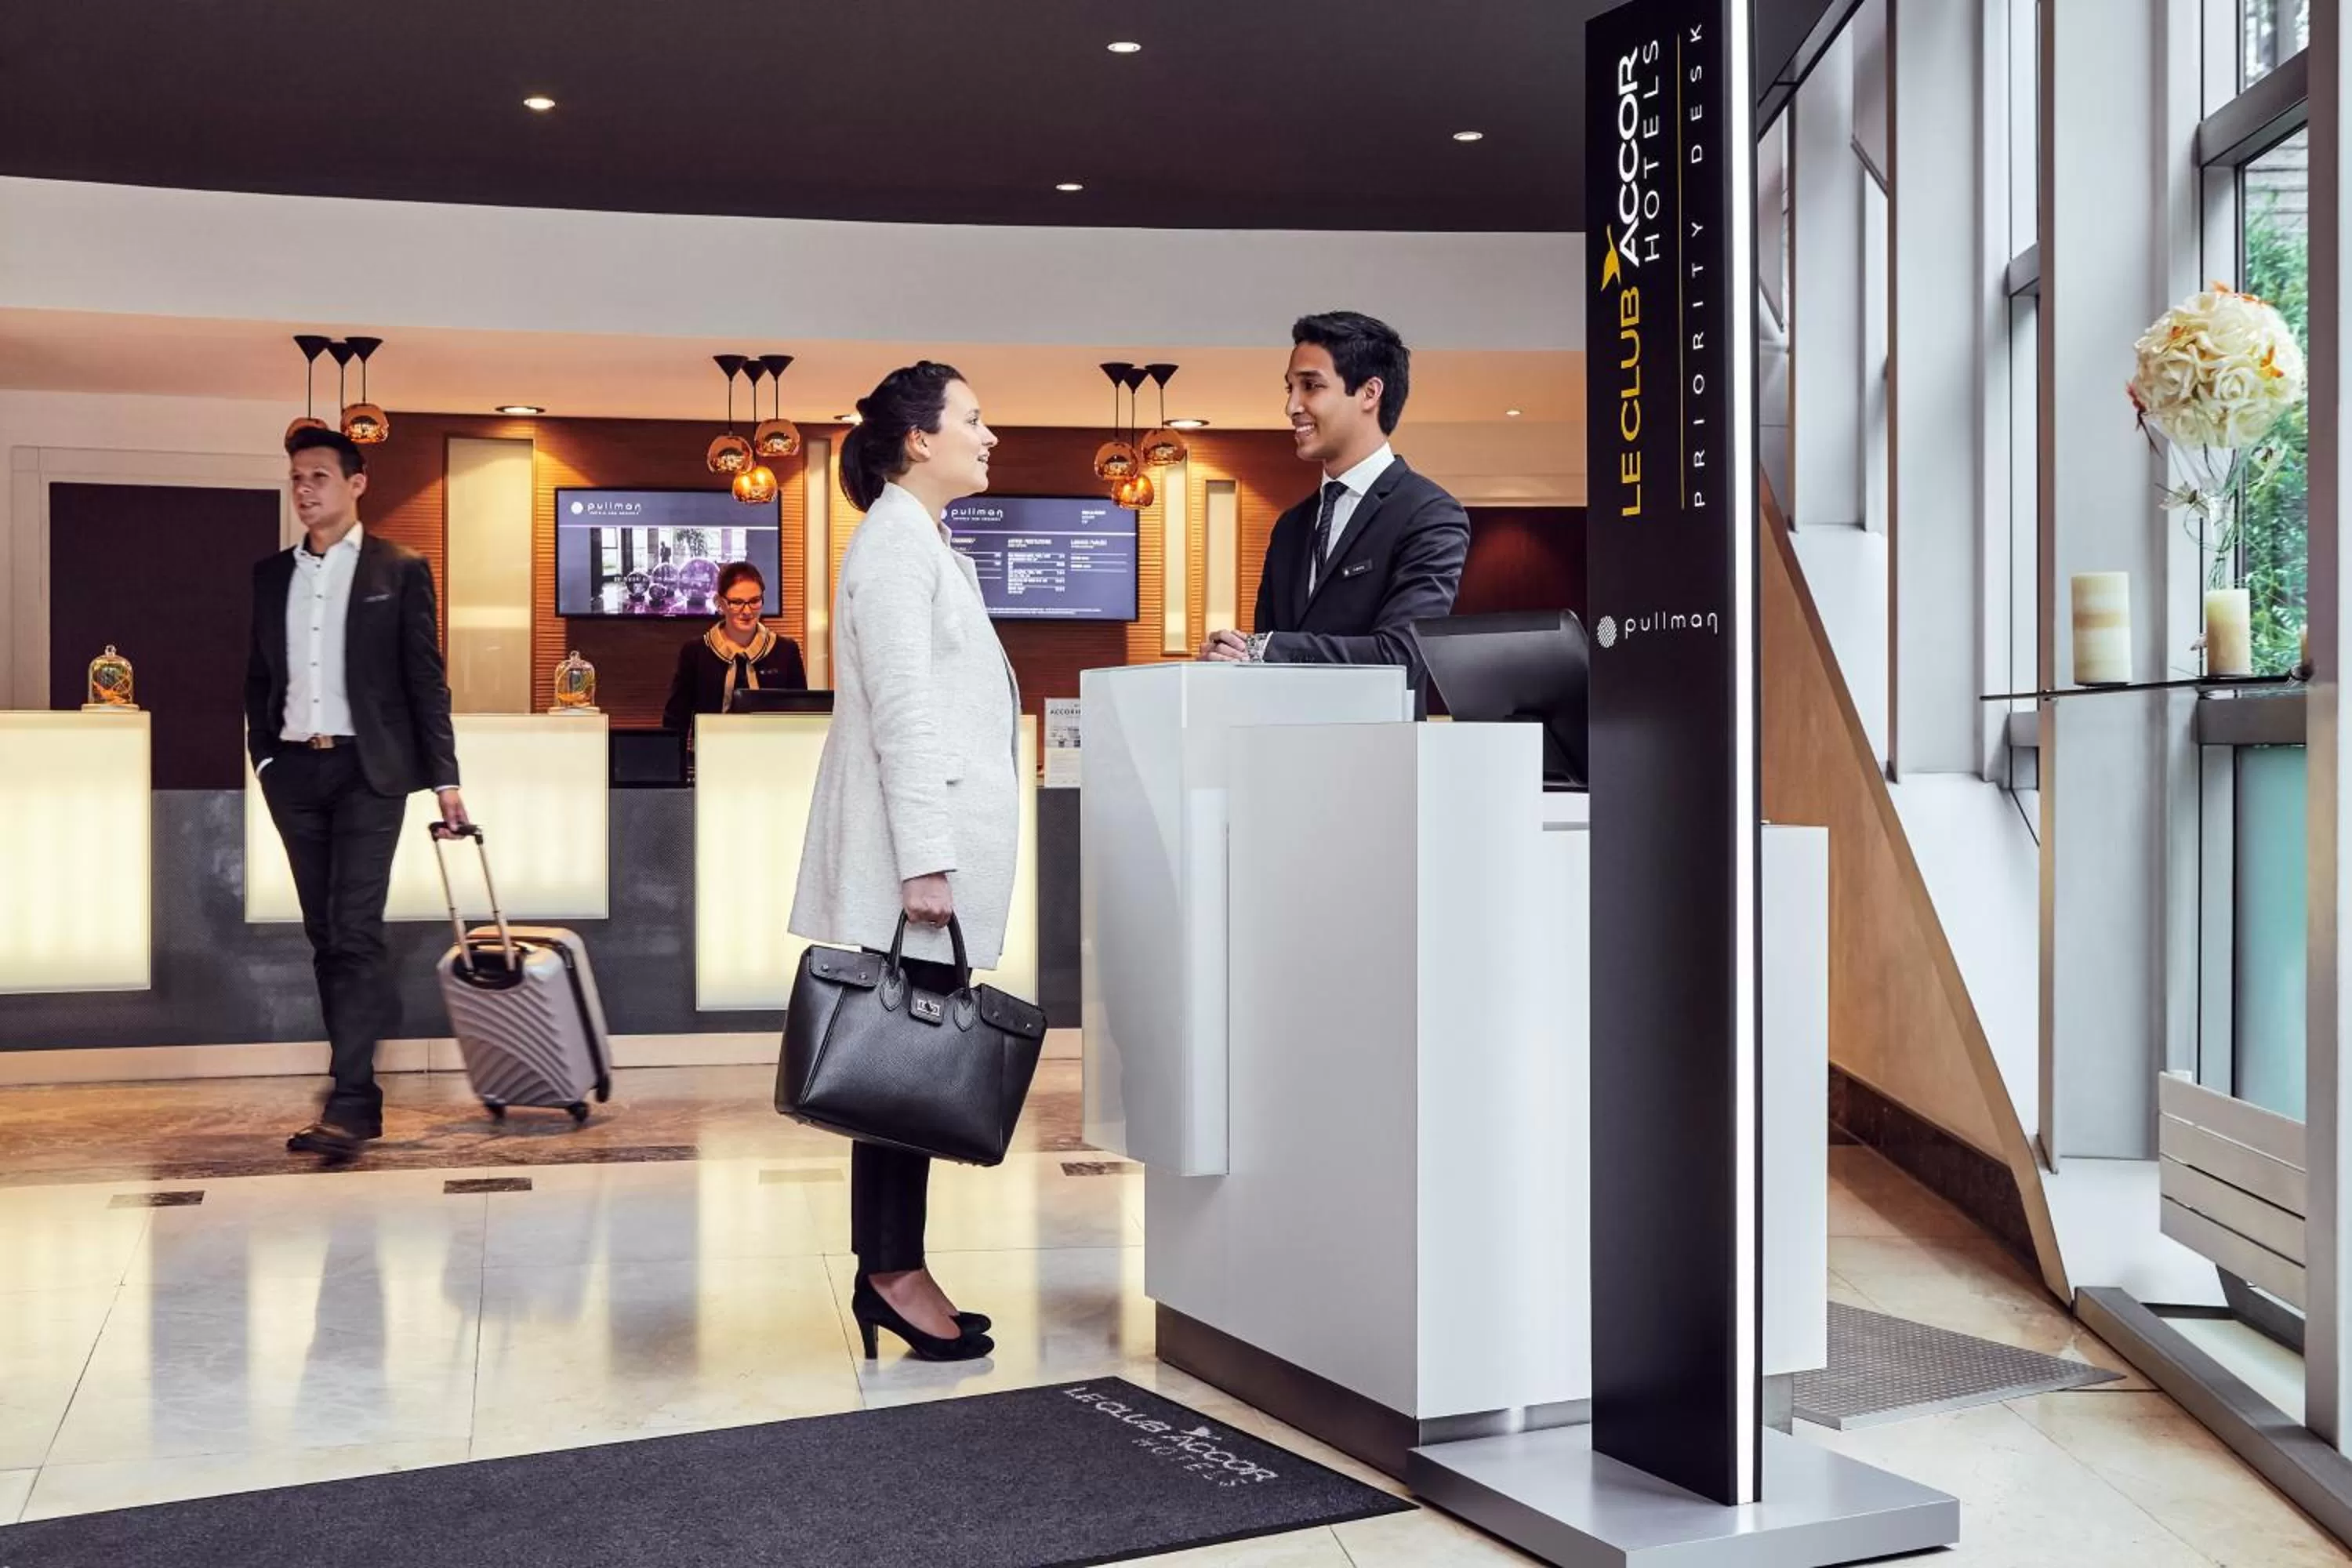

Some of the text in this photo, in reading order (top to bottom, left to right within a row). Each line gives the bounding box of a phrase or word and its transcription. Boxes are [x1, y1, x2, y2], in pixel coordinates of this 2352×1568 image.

[1642, 39, 1660, 263] HOTELS
[1617, 45, 1642, 517] LE CLUB ACCOR
[1690, 24, 1706, 508] PRIORITY DESK
[587, 501, 642, 513] pullman
[950, 508, 1004, 519] pullman
[1624, 611, 1719, 640] pullman
[1094, 1400, 1172, 1433] CLUB
